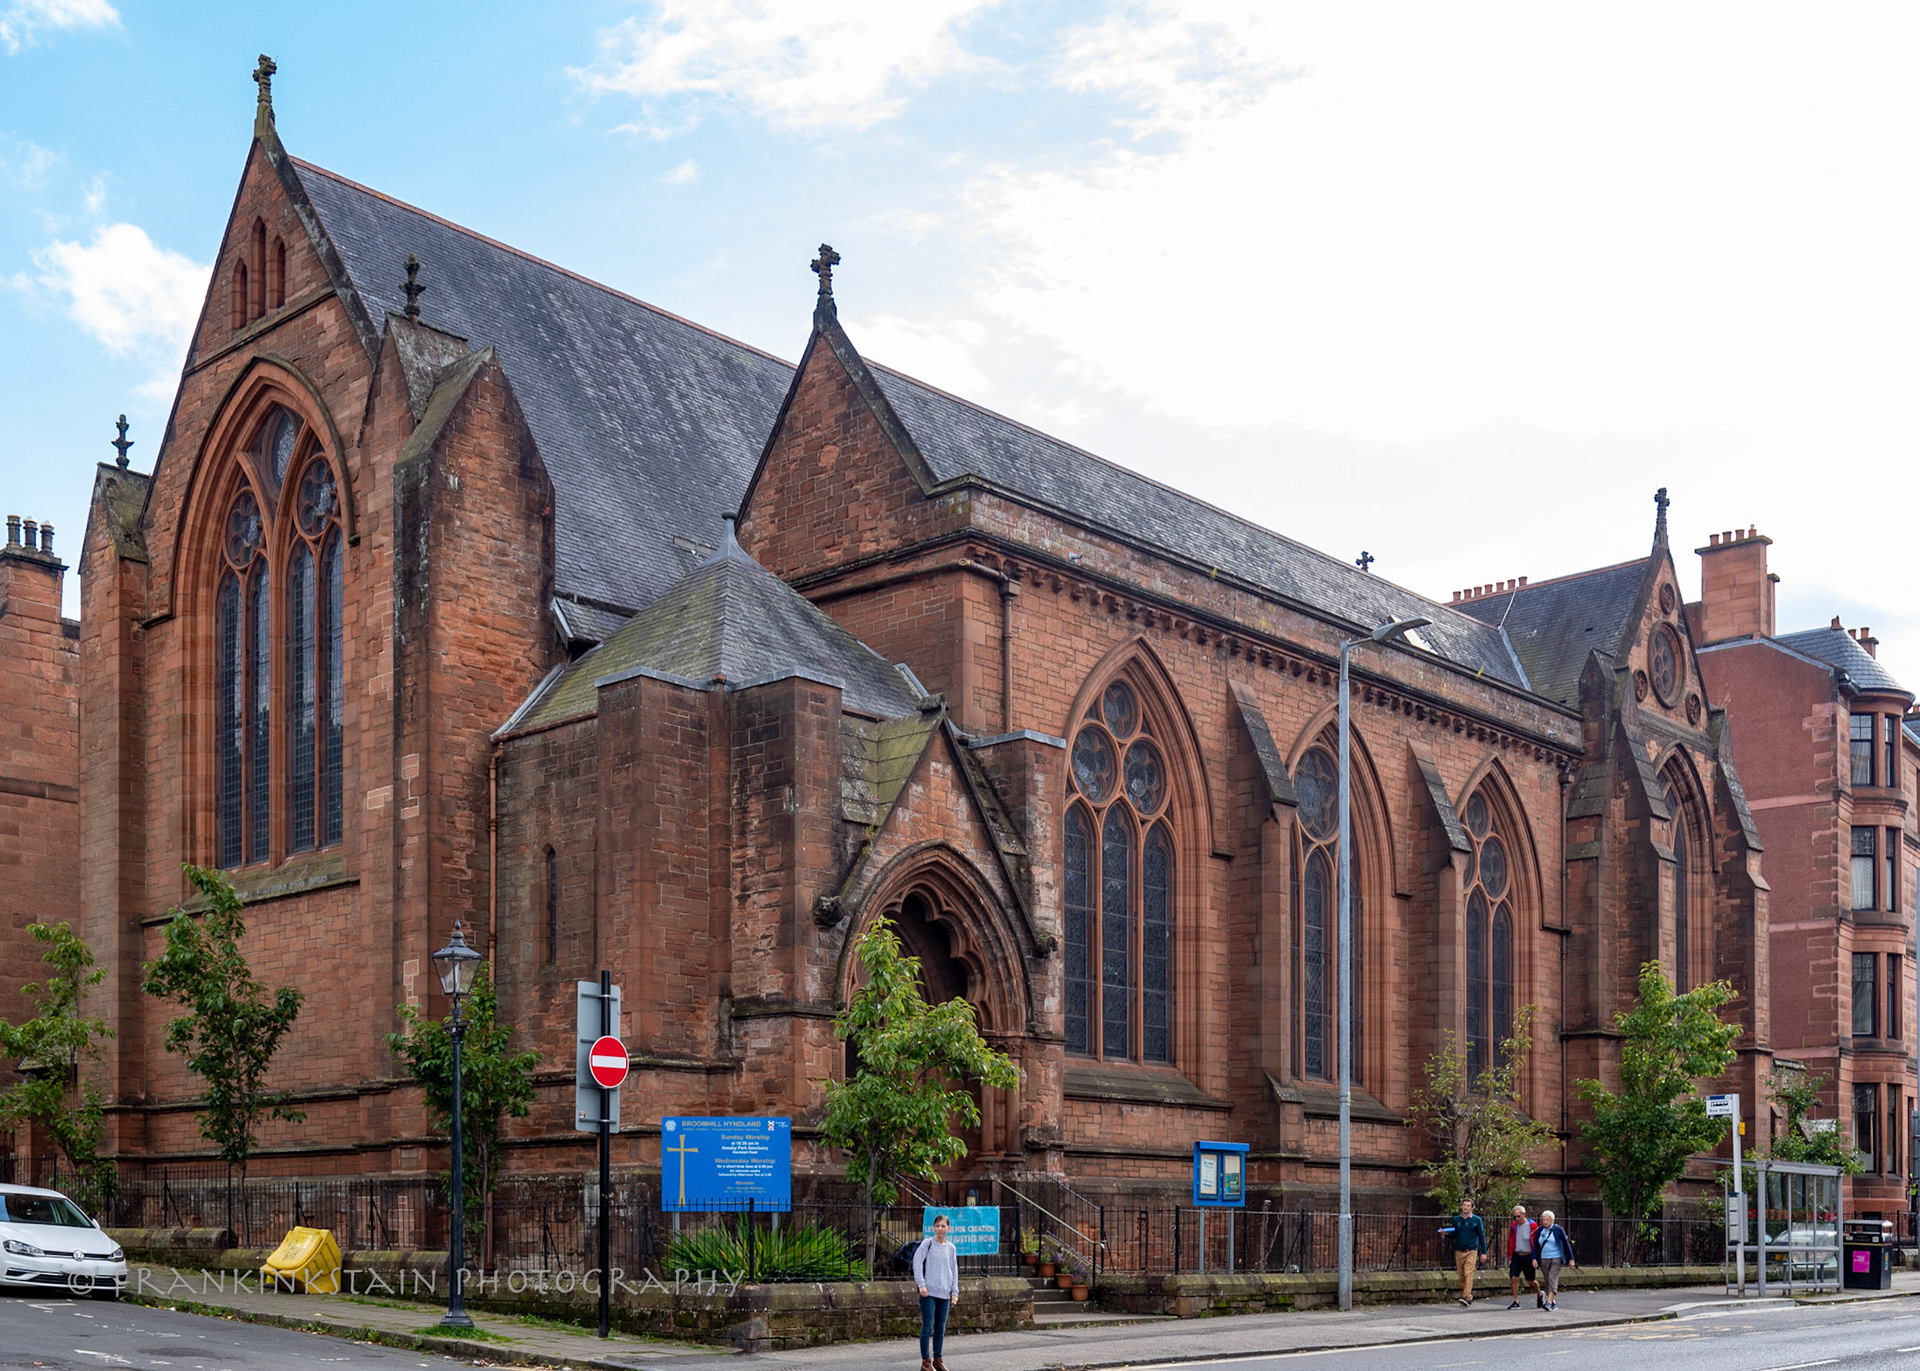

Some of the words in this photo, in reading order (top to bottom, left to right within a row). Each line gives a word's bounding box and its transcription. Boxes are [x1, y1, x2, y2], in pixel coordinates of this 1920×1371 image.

[681, 1120, 722, 1128] BROOMHILL
[723, 1120, 762, 1128] HYNDLAND
[953, 1235, 977, 1243] JUSTICE
